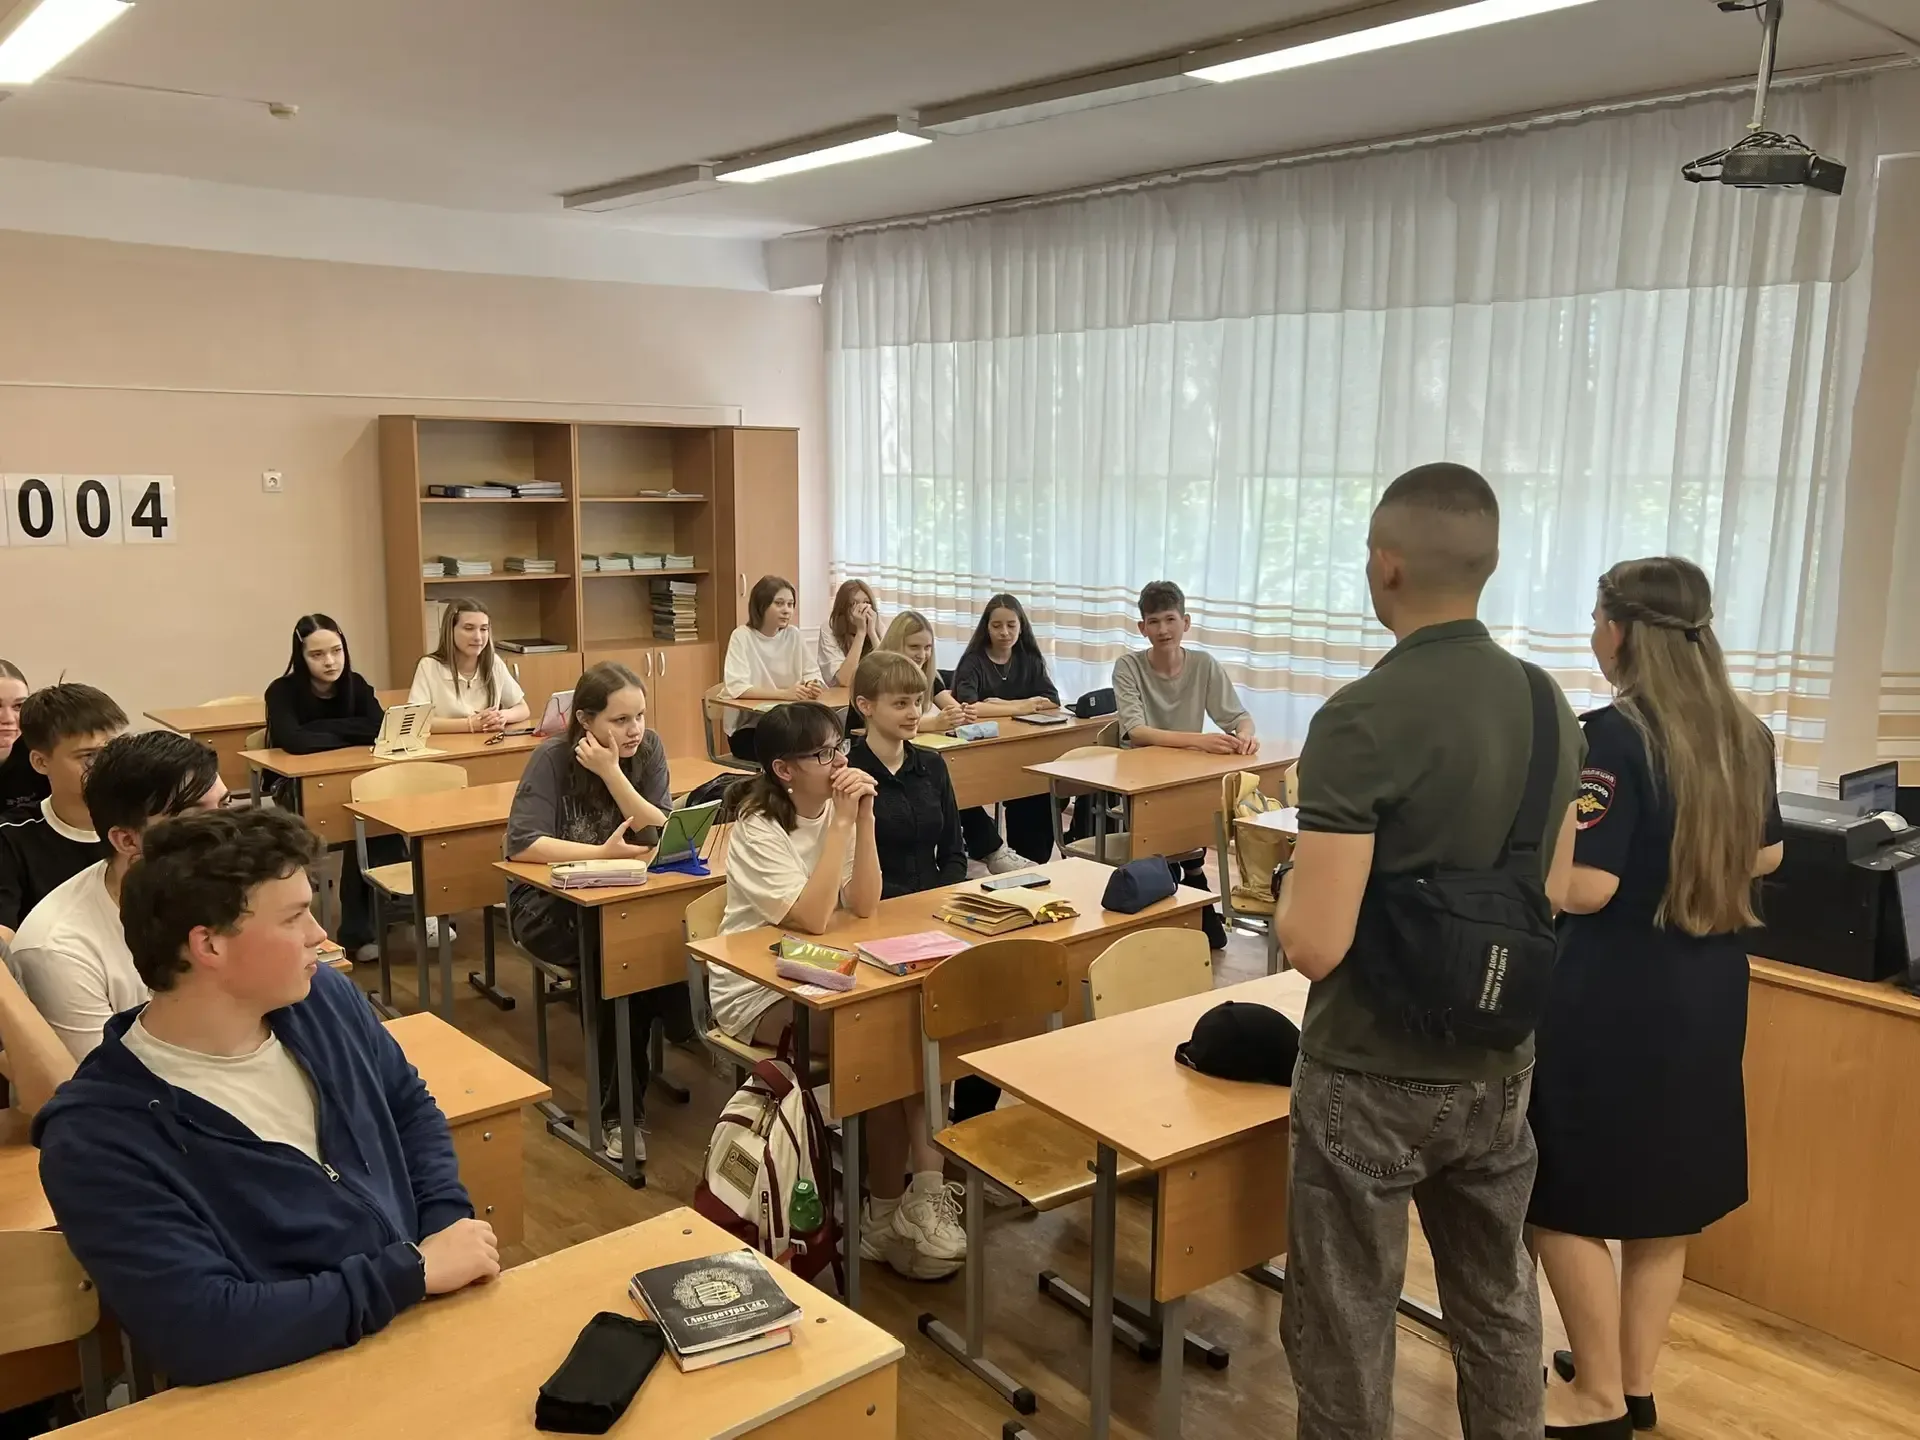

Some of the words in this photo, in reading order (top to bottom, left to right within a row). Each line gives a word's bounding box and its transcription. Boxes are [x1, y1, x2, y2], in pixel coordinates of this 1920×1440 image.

[18, 478, 168, 538] 004
[1581, 782, 1609, 798] ОССИЯ
[1489, 944, 1499, 970] ДОБРО
[1496, 948, 1508, 980] РАДОСТЬ
